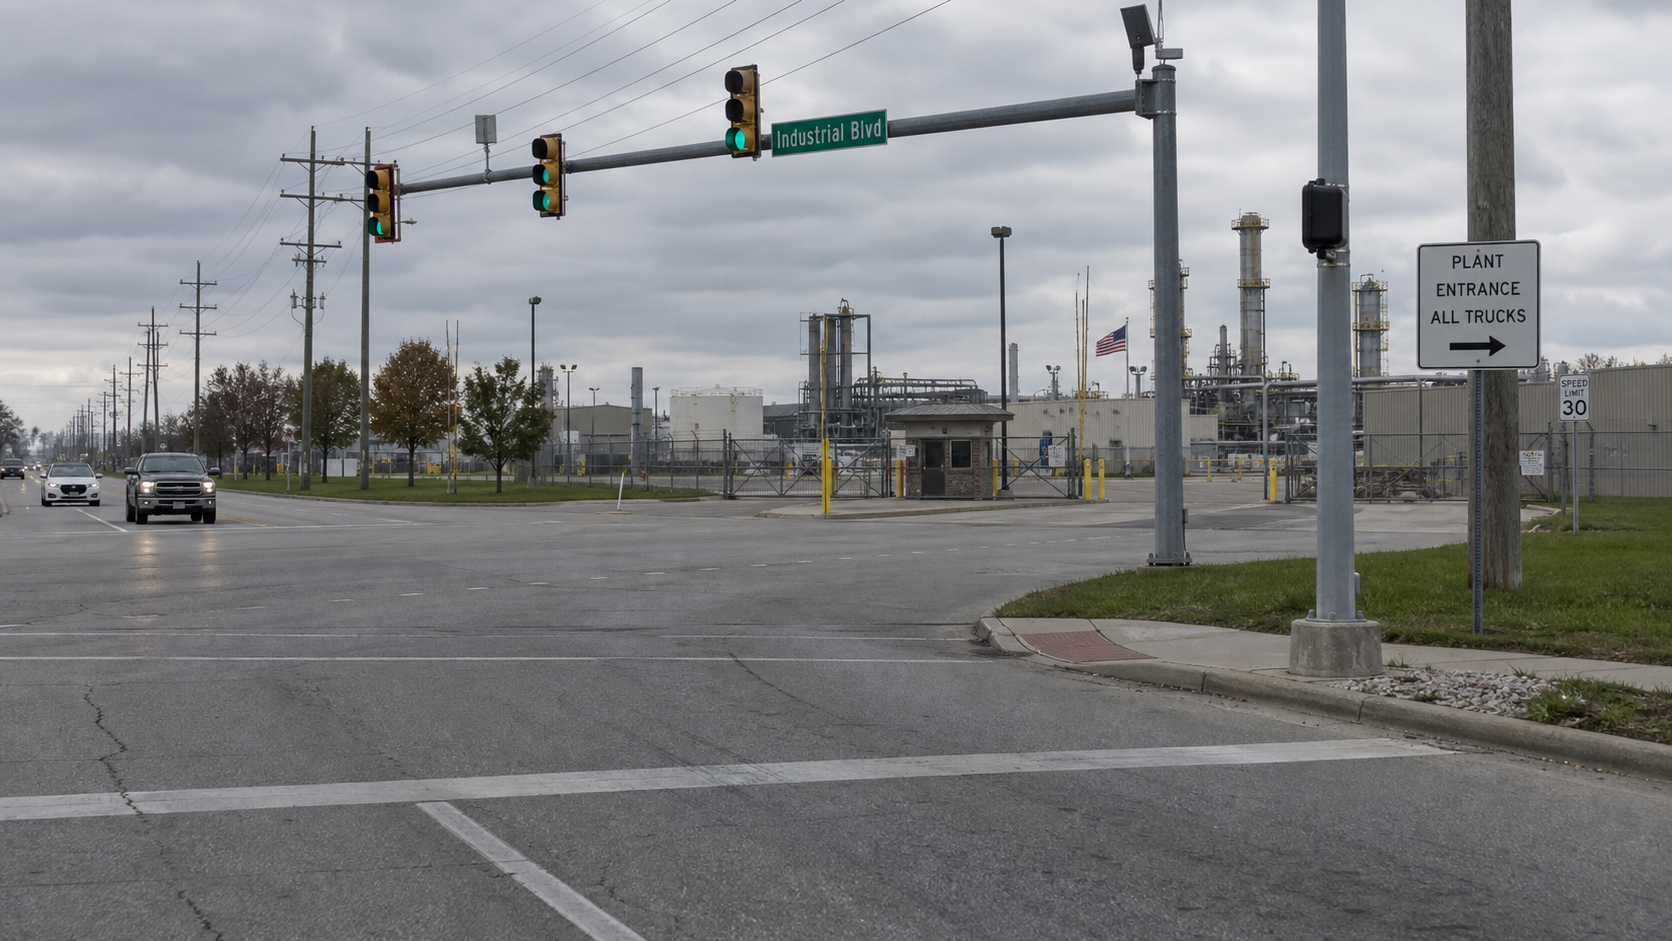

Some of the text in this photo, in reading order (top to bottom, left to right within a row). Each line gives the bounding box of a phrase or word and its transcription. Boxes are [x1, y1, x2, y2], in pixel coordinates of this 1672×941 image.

[777, 118, 882, 149] Industrial Blvd
[1452, 254, 1504, 269] PLANT
[1436, 281, 1520, 297] ENTRANCE
[1430, 308, 1526, 324] ALL TRUCKS
[1561, 379, 1588, 388] SPEED
[1564, 389, 1585, 397] LIMIT
[1562, 399, 1587, 416] 30
